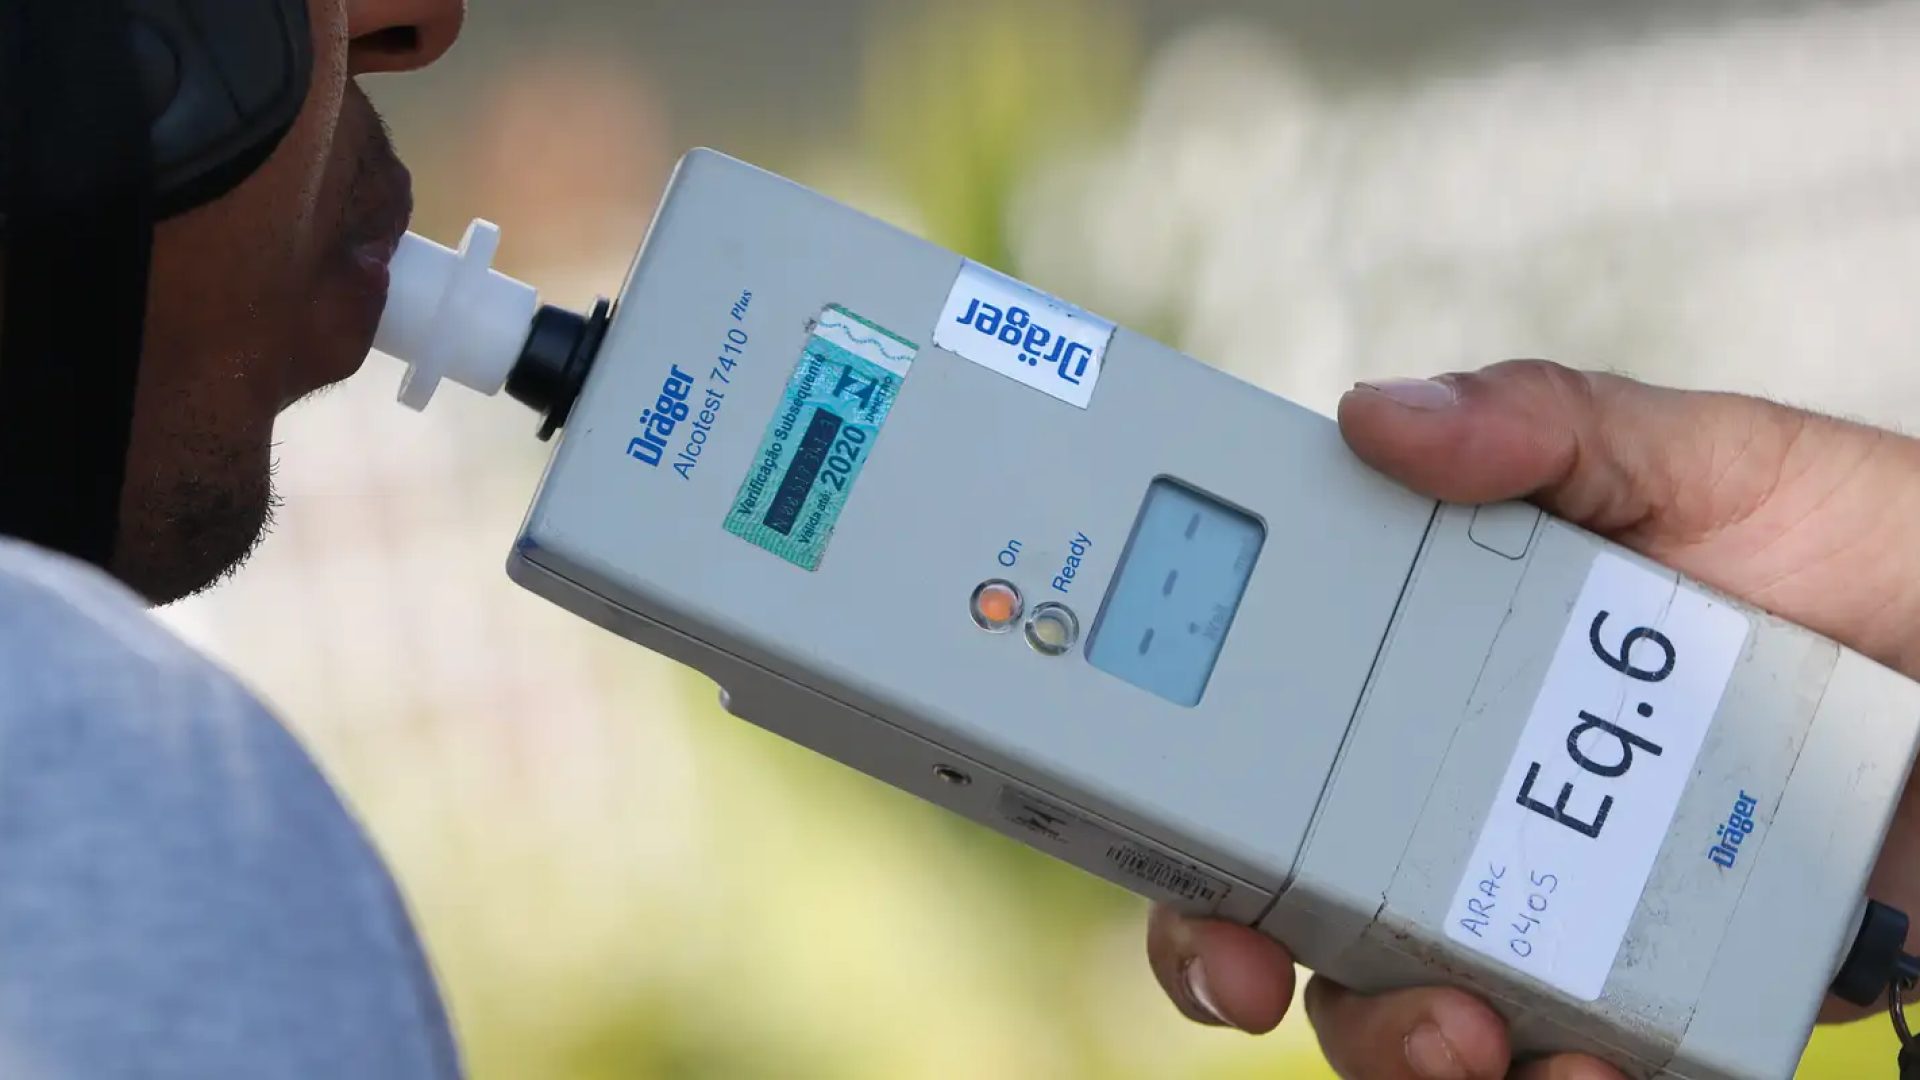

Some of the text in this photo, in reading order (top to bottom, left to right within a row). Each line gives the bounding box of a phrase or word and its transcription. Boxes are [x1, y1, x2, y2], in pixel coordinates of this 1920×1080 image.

[673, 289, 752, 480] Alcotest 7410 Plus
[956, 298, 1093, 385] Dräger
[626, 364, 694, 467] Dräger
[737, 353, 826, 516] Verificação Subsequente
[821, 426, 866, 491] 2020
[998, 540, 1022, 567] On
[1052, 532, 1092, 593] Ready
[1515, 610, 1676, 838] Eq.6
[1707, 790, 1757, 869] Dräger
[1460, 863, 1506, 937] ARAC
[1510, 870, 1557, 957] 0405
